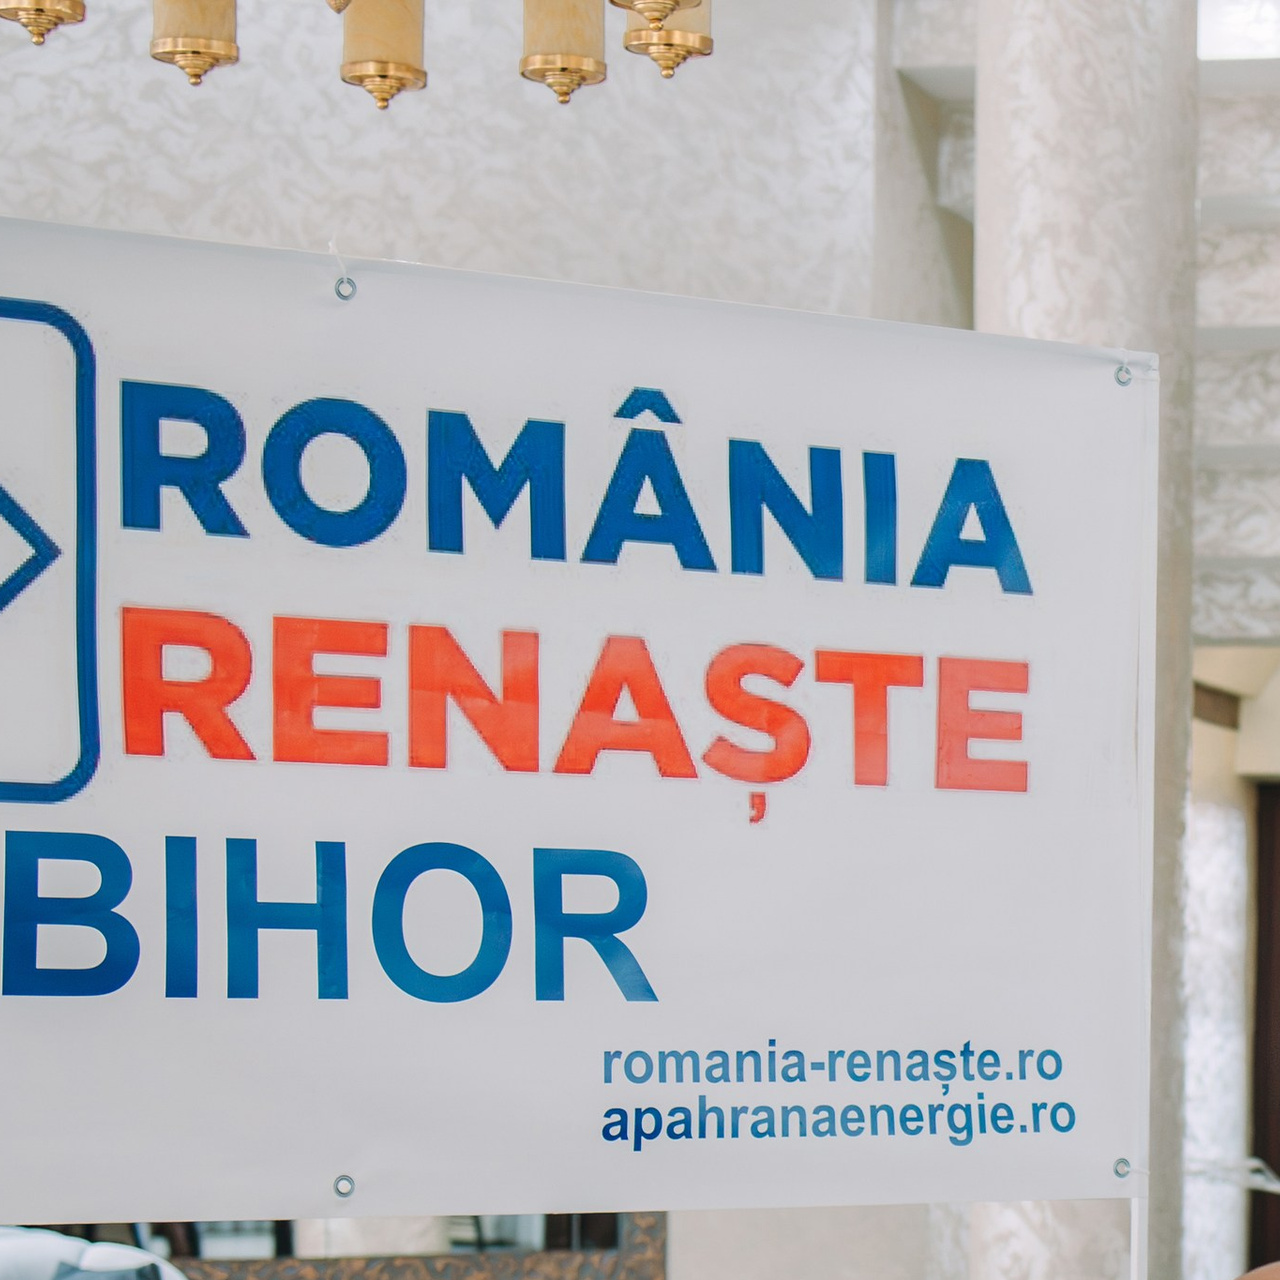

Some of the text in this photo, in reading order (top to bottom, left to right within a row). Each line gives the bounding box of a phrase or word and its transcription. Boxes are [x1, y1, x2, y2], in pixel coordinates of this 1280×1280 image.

[120, 380, 1034, 595] ROMÂNIA
[120, 604, 1031, 824] RENAȘTE
[1, 830, 660, 1004] BIHOR
[601, 1092, 1078, 1153] apahranaenergie.ro
[603, 1038, 1065, 1097] romania-renaște.ro
